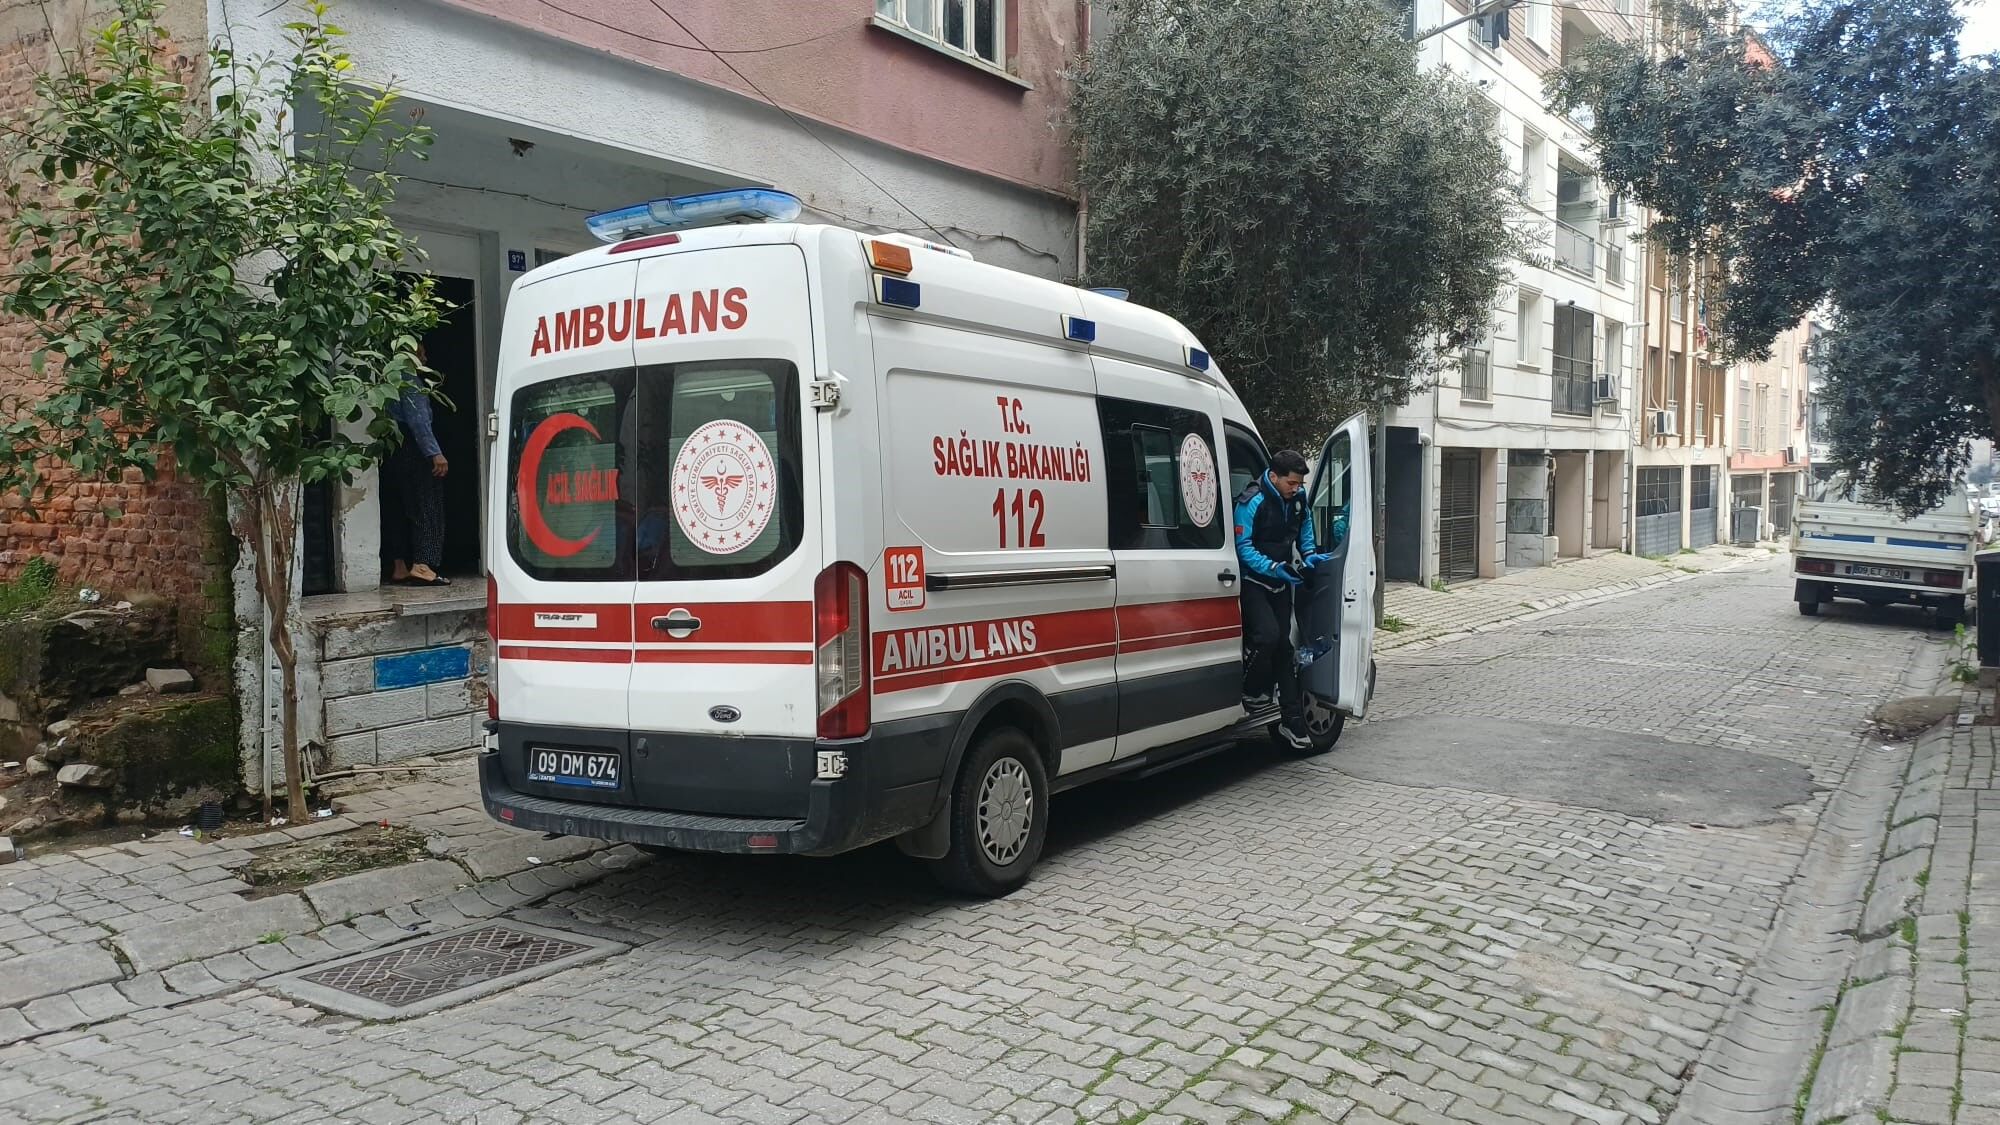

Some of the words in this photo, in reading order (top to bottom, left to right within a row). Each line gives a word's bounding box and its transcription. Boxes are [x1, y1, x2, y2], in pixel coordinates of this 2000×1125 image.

[530, 287, 748, 357] AMBULANS
[997, 396, 1031, 434] T.C.
[690, 446, 729, 485] CUMHURİYETİ
[729, 447, 752, 472] SAĞLIK
[933, 429, 1003, 477] SAĞLIK
[1006, 440, 1091, 483] BAKANLIĞI
[575, 464, 619, 503] SAĞLIK
[736, 474, 755, 521] BAKANLIĞI
[993, 488, 1046, 549] 112
[890, 554, 919, 583] 112
[881, 620, 1037, 672] AMBULANS
[538, 752, 557, 773] 09
[561, 753, 584, 775] DM
[588, 756, 616, 778] 674
